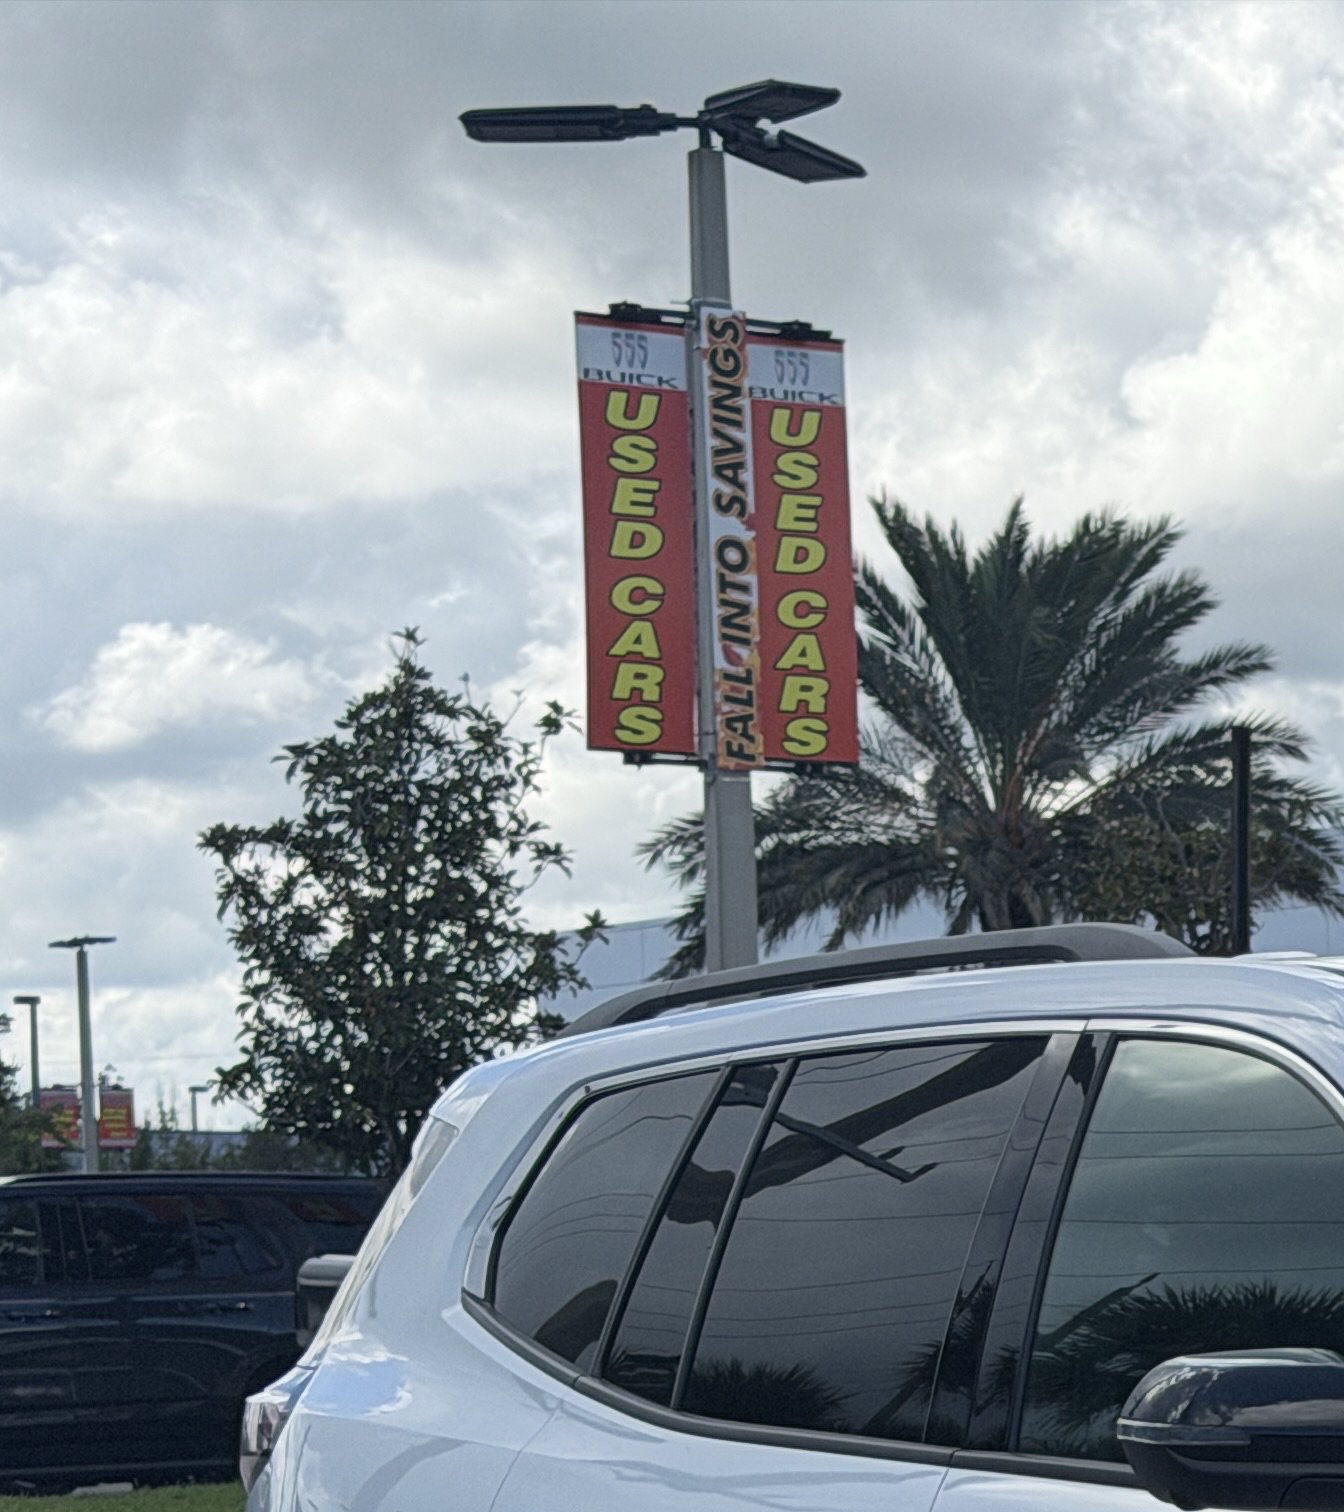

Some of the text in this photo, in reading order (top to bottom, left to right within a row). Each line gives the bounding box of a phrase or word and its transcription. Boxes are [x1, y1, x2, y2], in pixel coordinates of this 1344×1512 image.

[583, 367, 679, 389] BUICK
[707, 314, 757, 763] FALL INTO SAVINGS
[749, 386, 840, 405] BUICK
[605, 390, 666, 746] USED CARS
[769, 406, 830, 757] USED CARS
